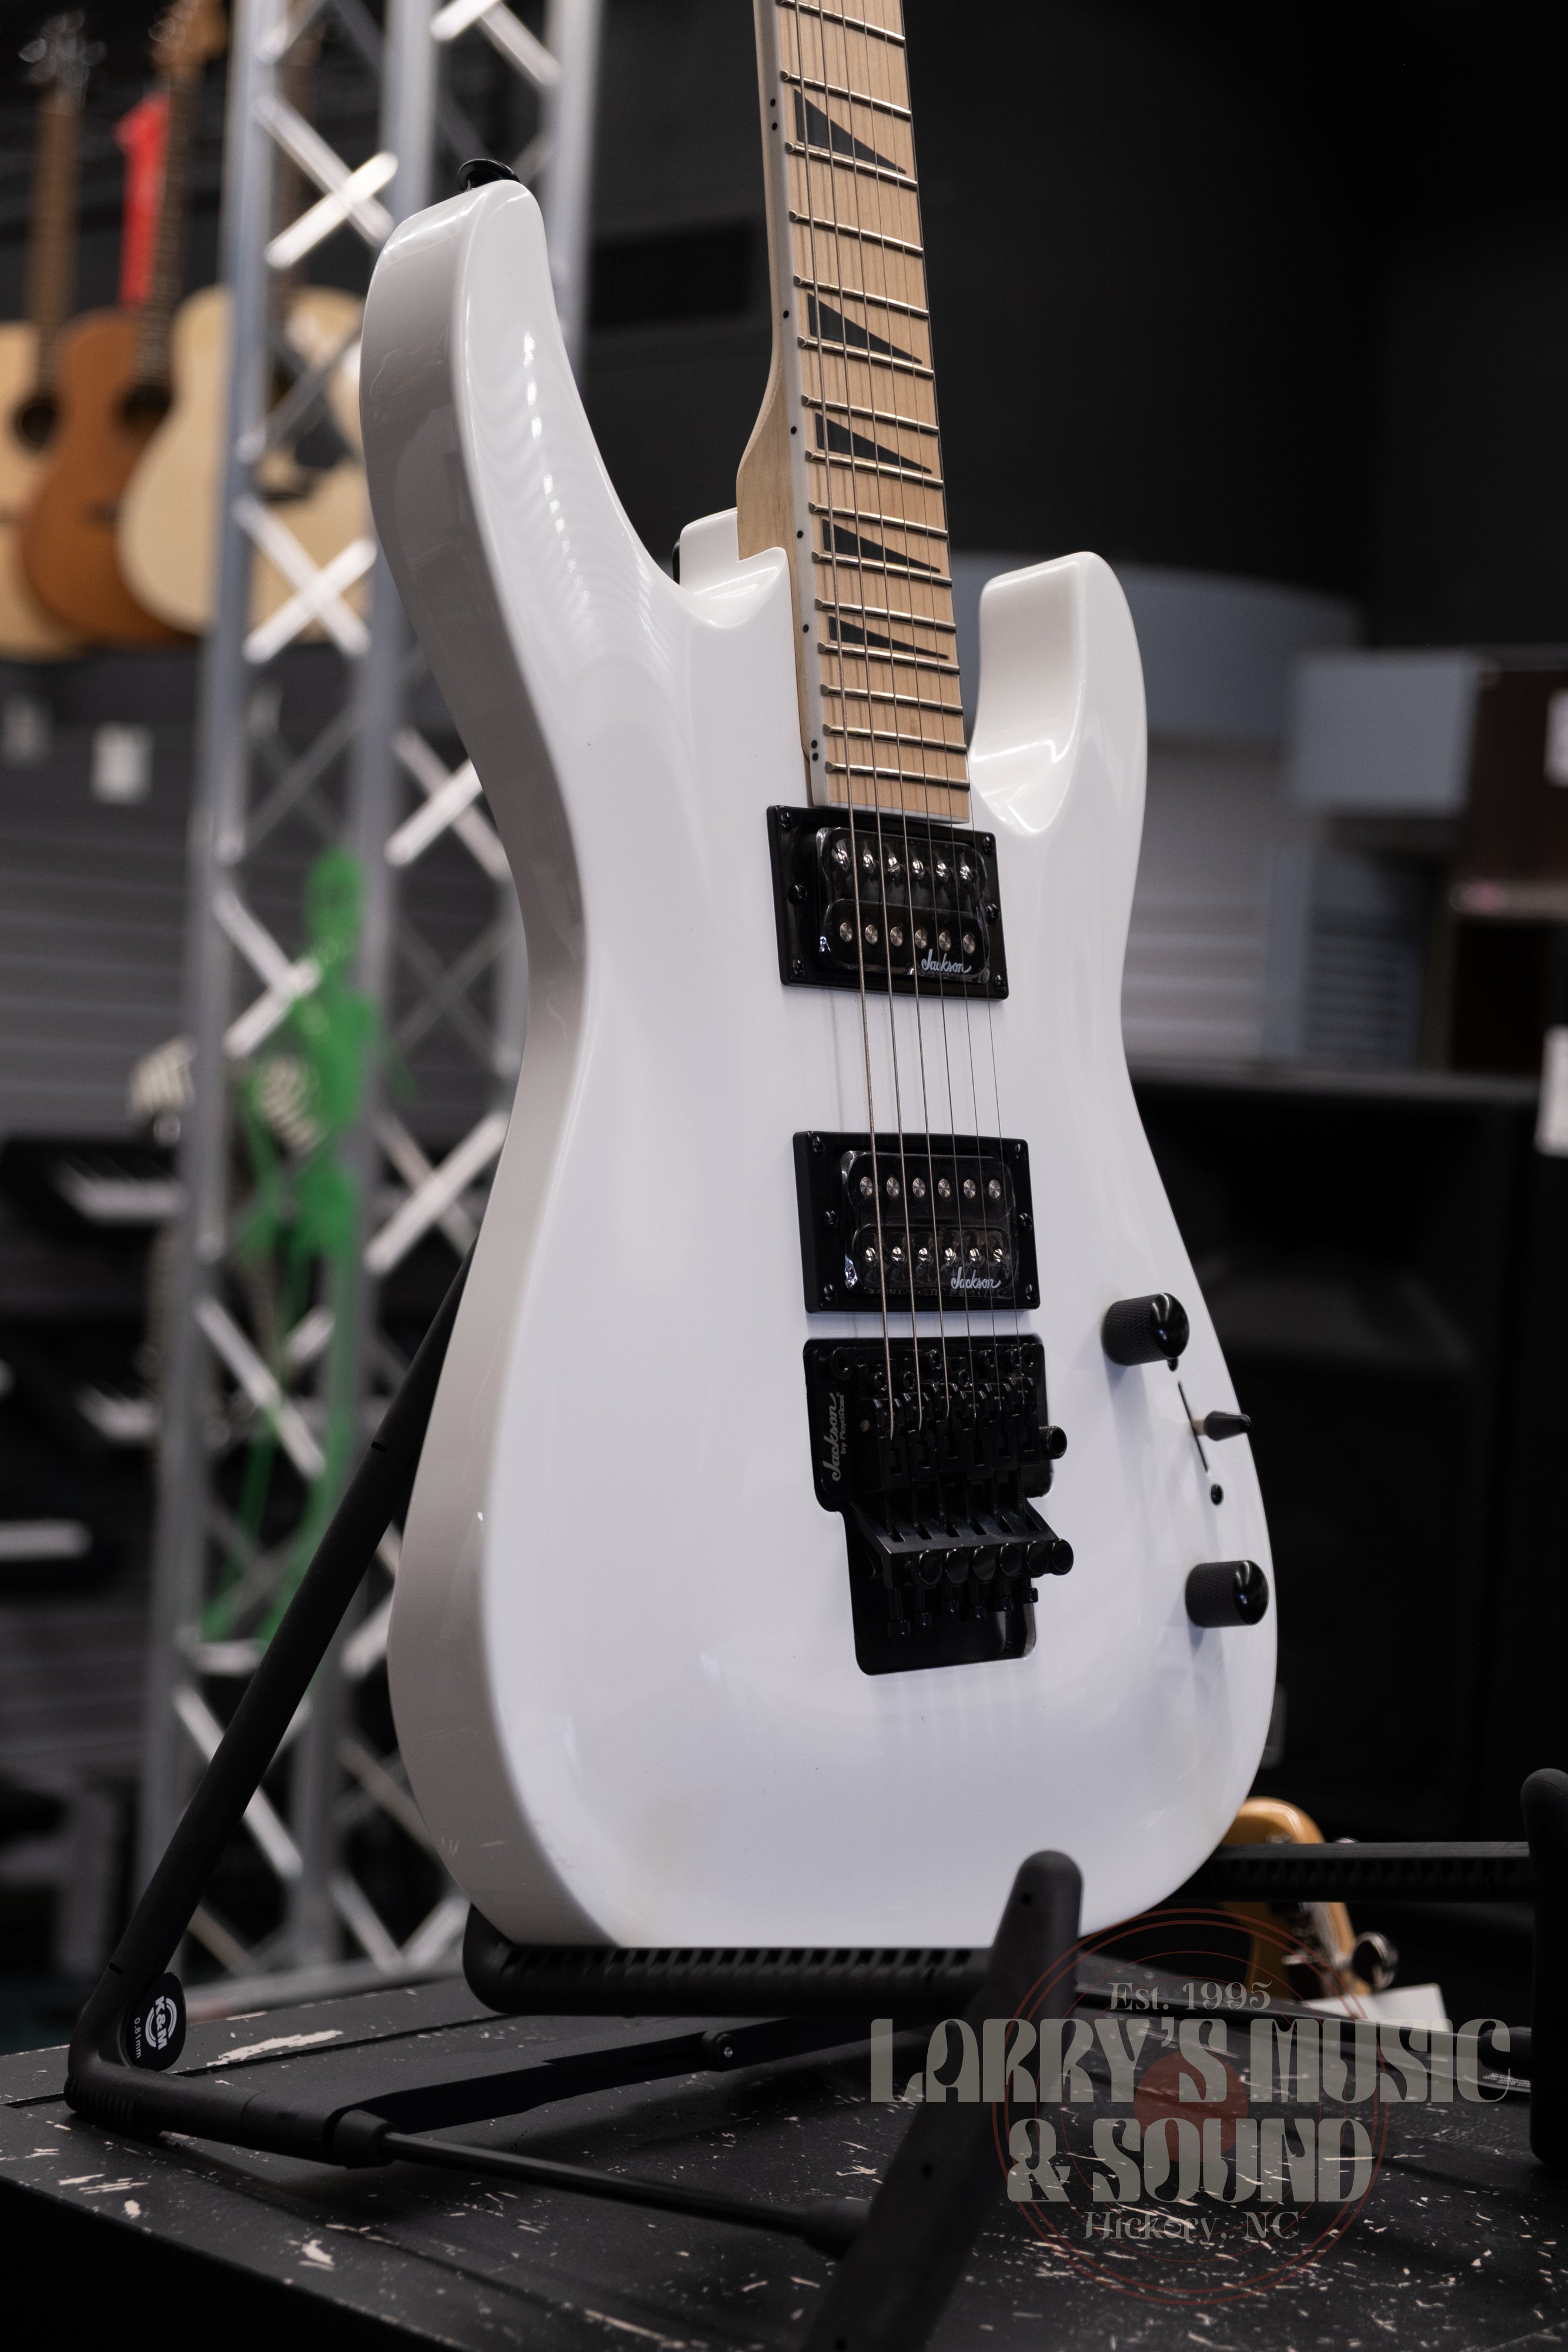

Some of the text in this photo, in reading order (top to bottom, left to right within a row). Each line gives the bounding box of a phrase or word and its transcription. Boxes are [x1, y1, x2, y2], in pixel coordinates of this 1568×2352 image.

[921, 948, 972, 973] Jackson
[951, 1267, 1001, 1289] Jackson
[823, 1392, 841, 1481] Jackson
[841, 1442, 847, 1454] by
